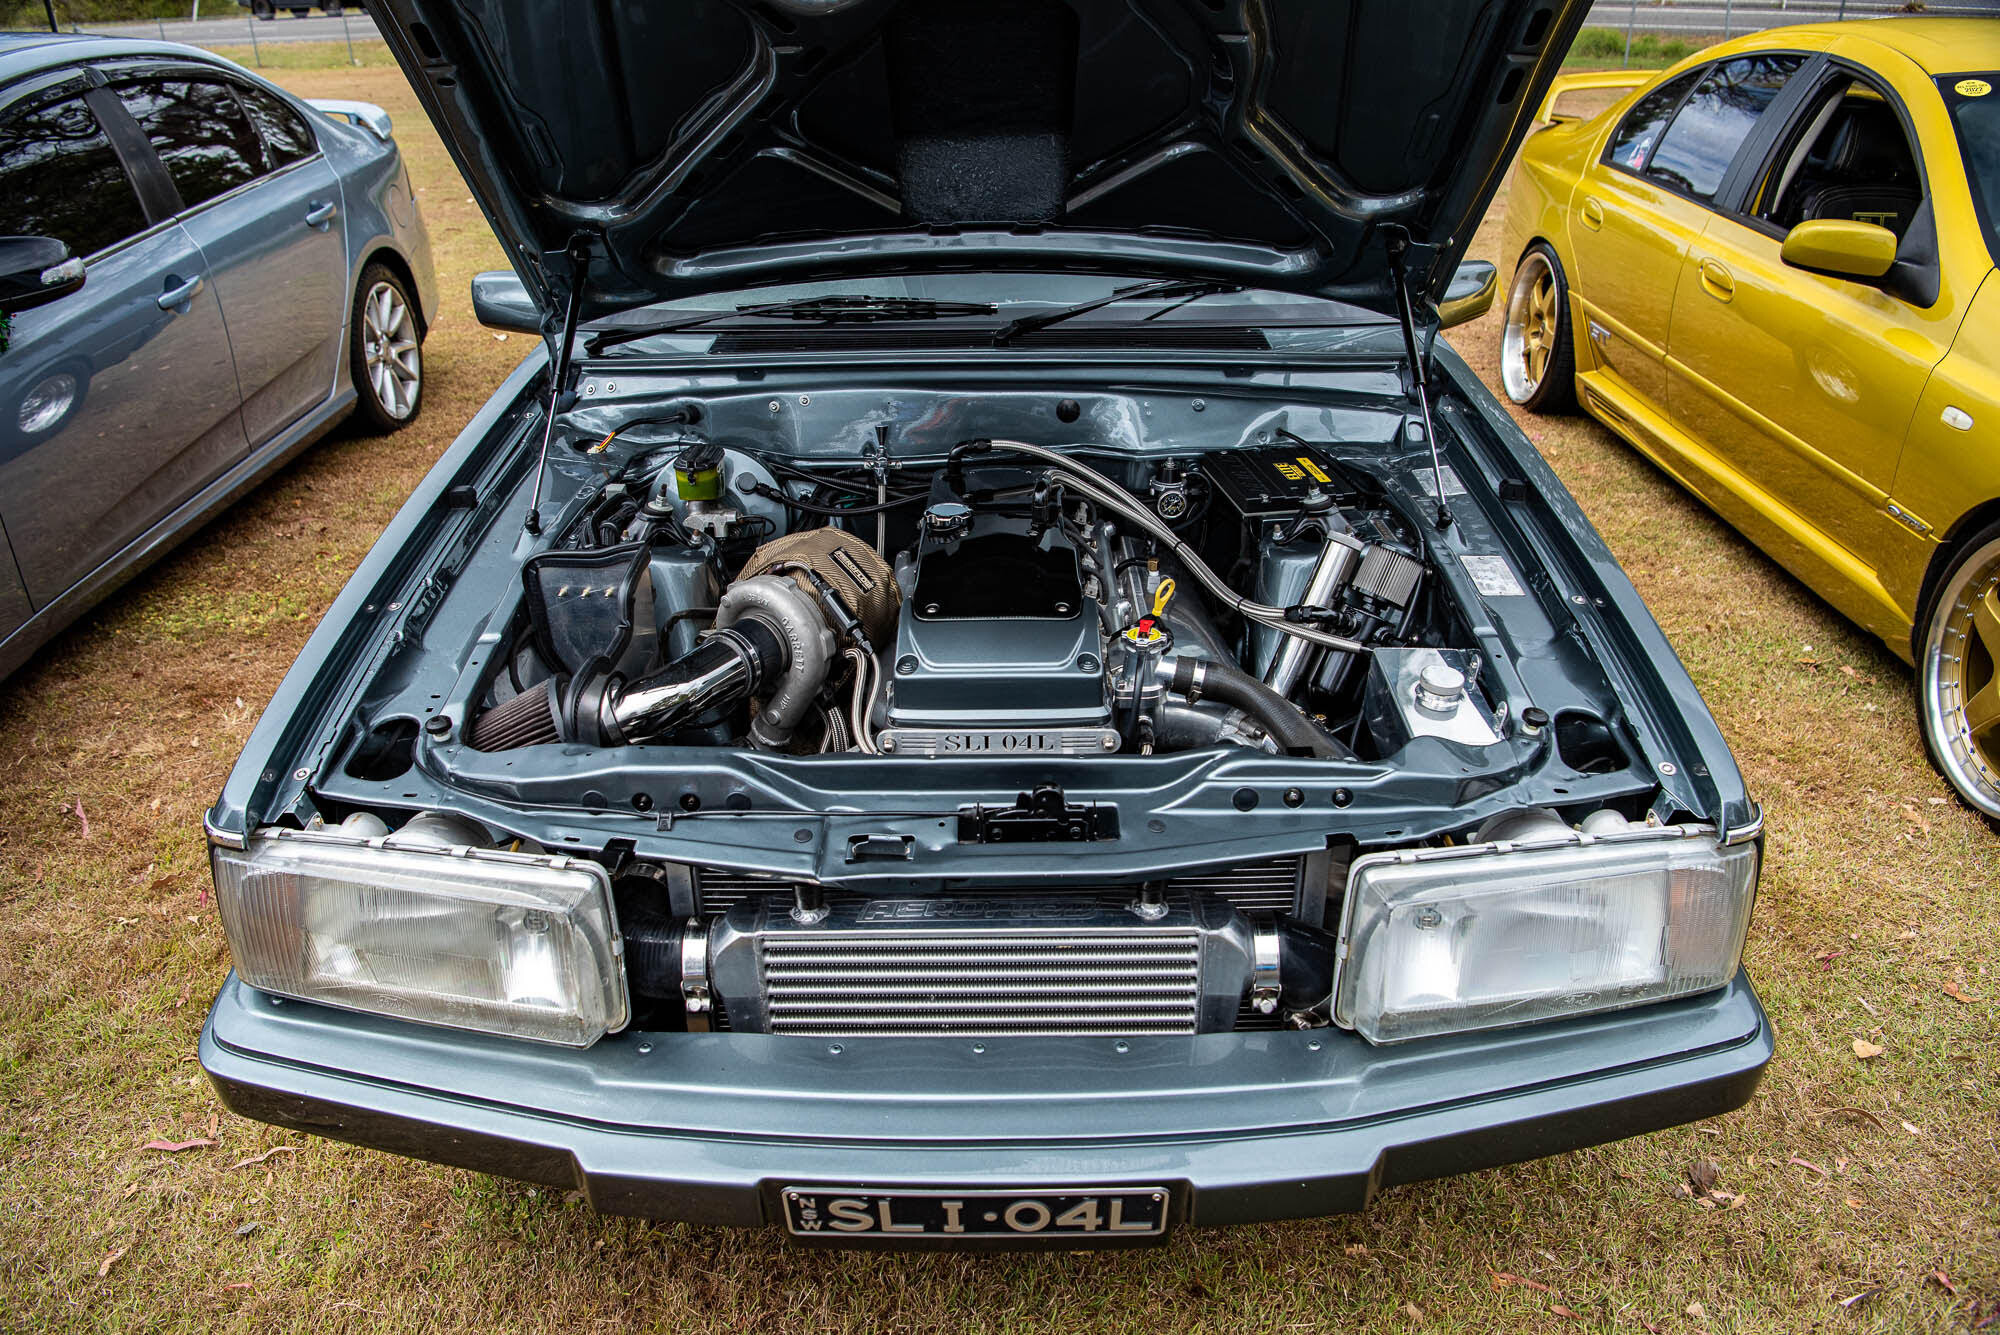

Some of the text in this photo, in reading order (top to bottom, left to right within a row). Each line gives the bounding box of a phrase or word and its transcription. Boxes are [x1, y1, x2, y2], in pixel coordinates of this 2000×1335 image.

[781, 616, 806, 674] GARRETT
[944, 734, 1055, 752] SLI 04L
